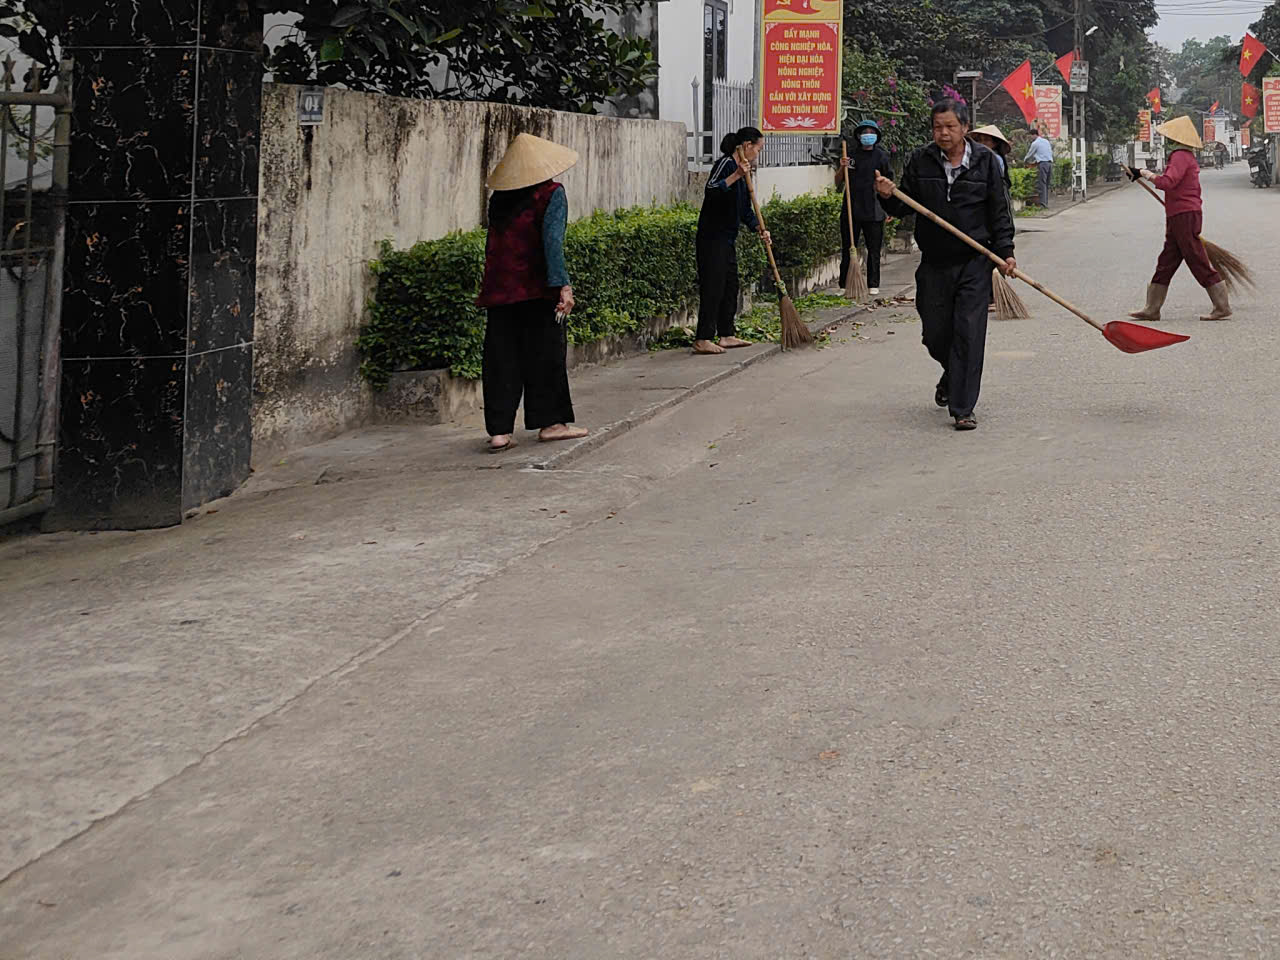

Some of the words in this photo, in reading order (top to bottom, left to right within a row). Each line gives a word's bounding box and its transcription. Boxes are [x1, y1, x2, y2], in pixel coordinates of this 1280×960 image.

[799, 29, 820, 40] MẠNH
[770, 41, 789, 51] CÔNG
[791, 41, 816, 52] NGHIỆP
[779, 54, 795, 65] HIỆN
[797, 55, 808, 65] ĐẠI
[809, 54, 824, 63] HÓA
[778, 66, 797, 76] NÔNG
[781, 79, 800, 89] NÔNG
[802, 79, 820, 89] THÔN
[785, 91, 797, 101] VỚI
[798, 91, 812, 101] XÂY
[812, 92, 832, 103] DỰNG
[771, 104, 791, 114] NÔNG
[793, 104, 810, 114] THÔN
